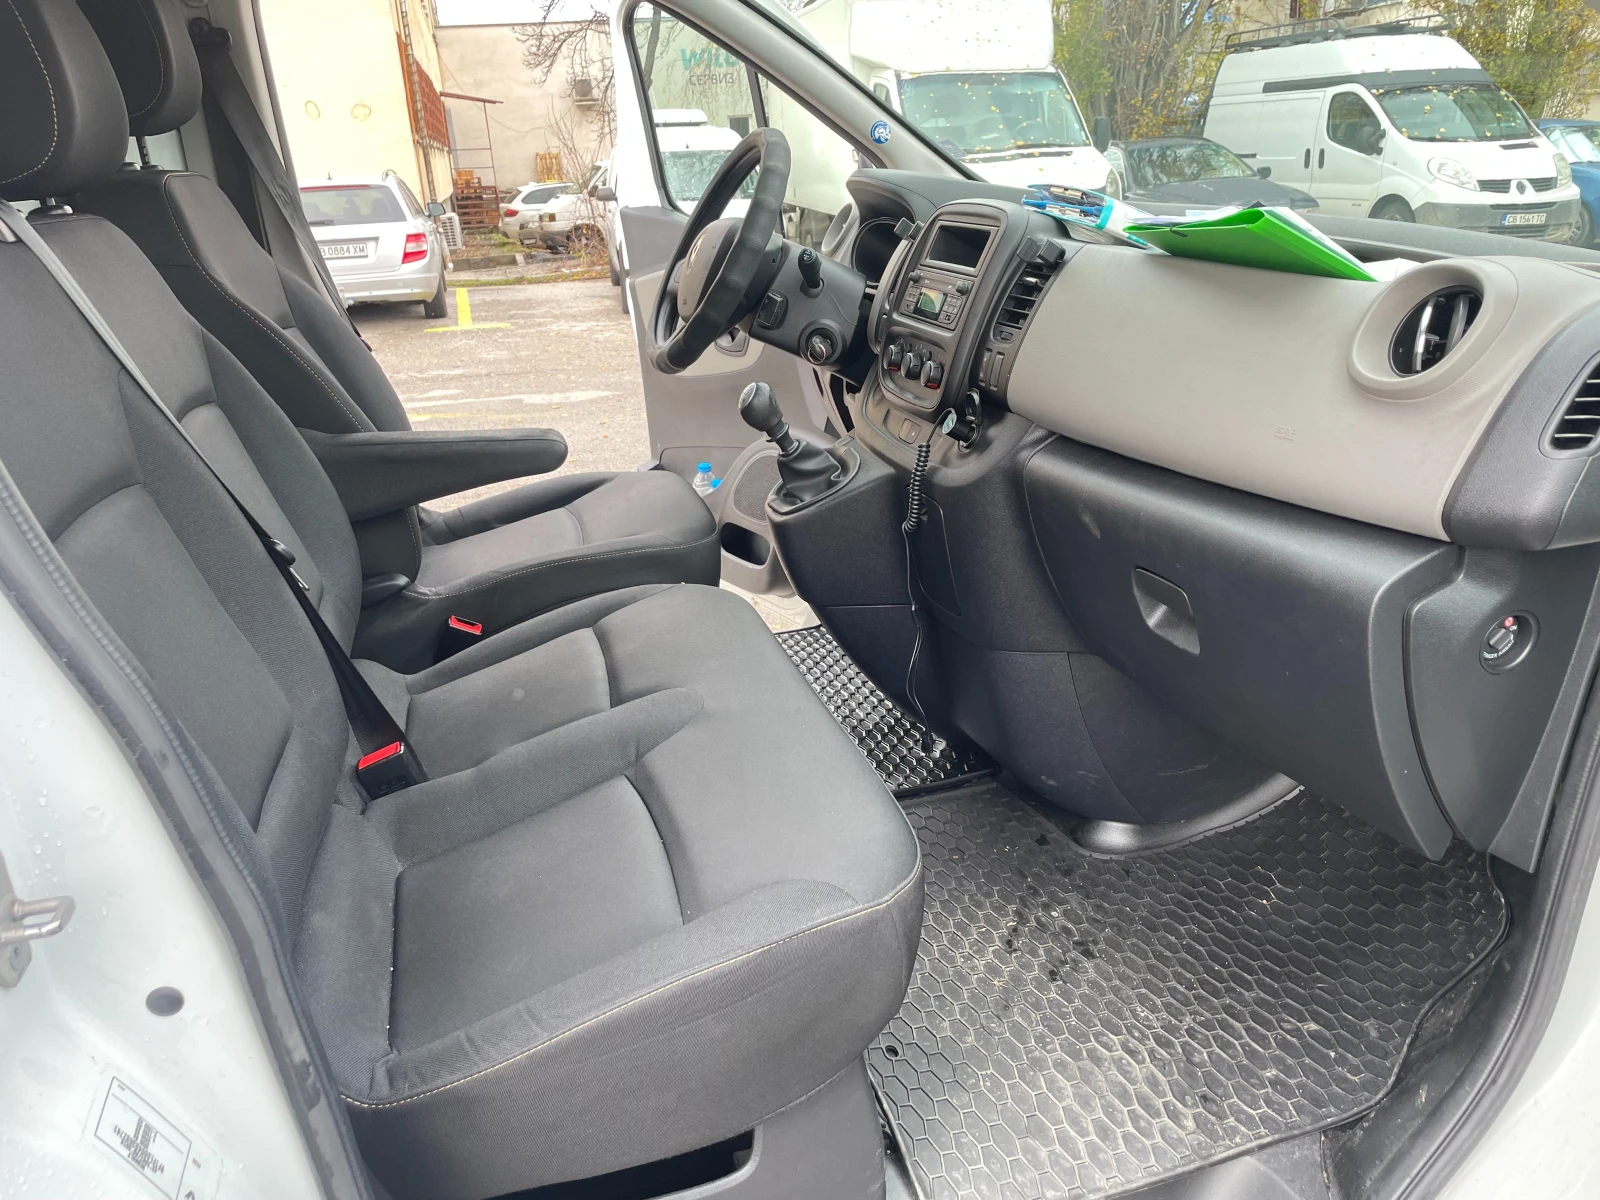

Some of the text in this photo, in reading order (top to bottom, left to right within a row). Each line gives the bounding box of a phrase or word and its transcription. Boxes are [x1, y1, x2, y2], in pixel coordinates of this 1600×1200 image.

[689, 72, 734, 86] СЕРВИЗ
[1519, 214, 1535, 224] 1561
[327, 245, 351, 256] 0884
[352, 244, 366, 255] XM
